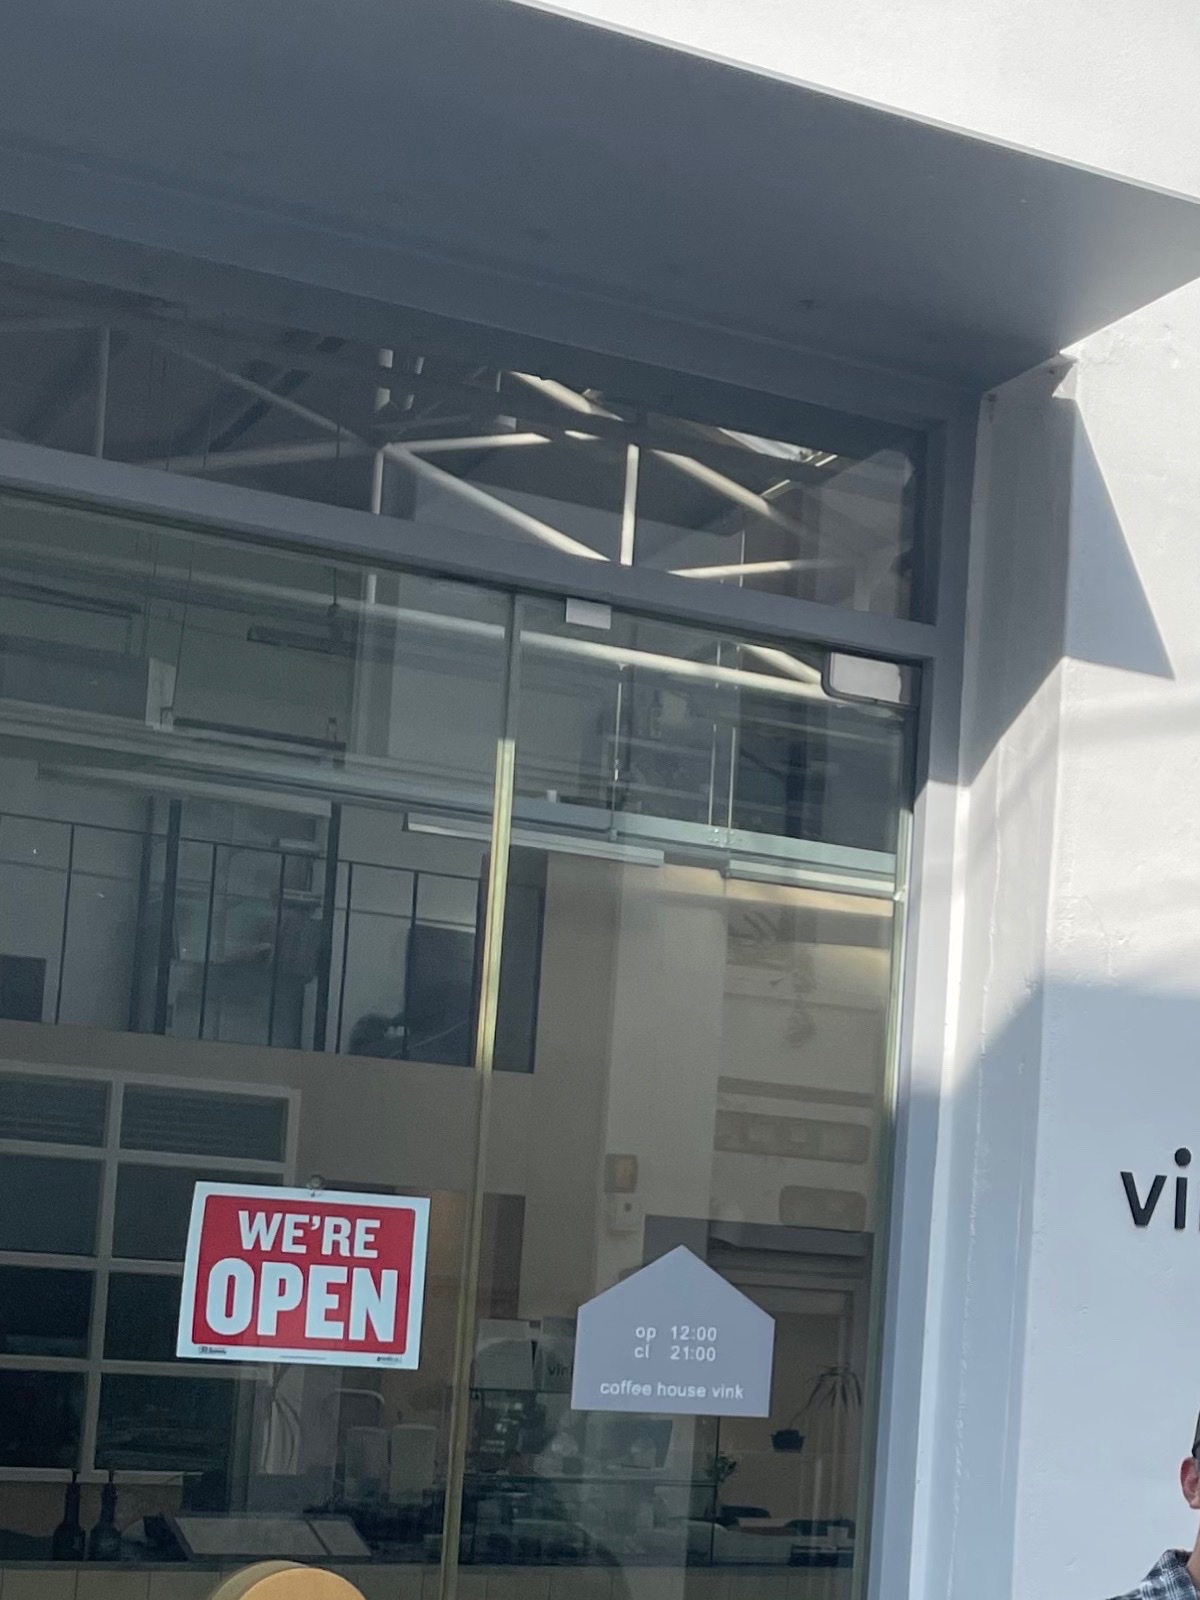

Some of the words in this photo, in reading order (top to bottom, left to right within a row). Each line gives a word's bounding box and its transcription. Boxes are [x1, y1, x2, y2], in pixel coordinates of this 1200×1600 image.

[238, 1209, 381, 1259] WE'RE
[205, 1257, 399, 1343] OPEN
[635, 1326, 657, 1342] op
[670, 1325, 718, 1342] 12:00
[634, 1344, 650, 1359] cl
[669, 1345, 717, 1362] 21:00
[599, 1379, 653, 1396] coffee
[657, 1381, 707, 1398] house
[712, 1382, 744, 1400] vink
